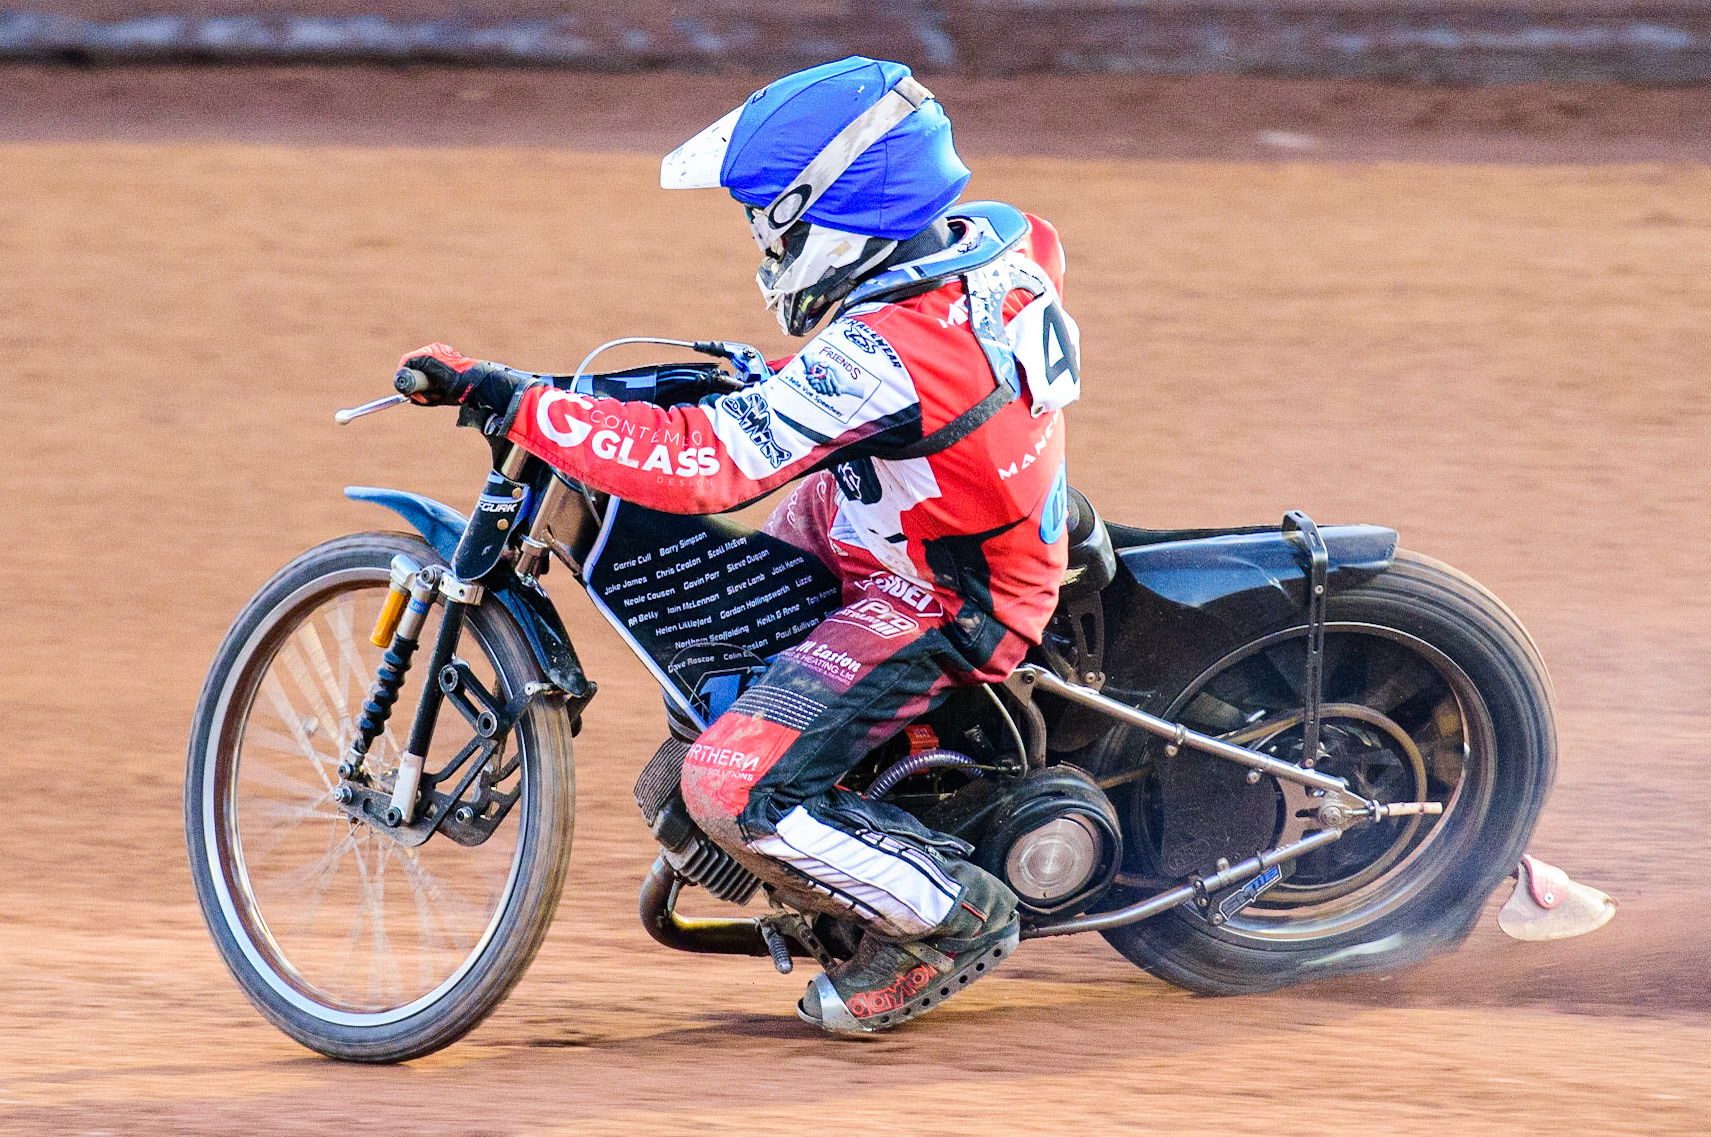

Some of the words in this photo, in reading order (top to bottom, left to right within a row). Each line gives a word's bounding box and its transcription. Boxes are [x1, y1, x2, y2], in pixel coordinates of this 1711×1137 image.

[1042, 300, 1079, 386] 4
[819, 345, 862, 381] FRIENDS
[802, 386, 814, 397] Vue
[591, 429, 720, 478] GLASS
[656, 476, 713, 488] DESIGN
[622, 576, 648, 588] James
[655, 566, 676, 580] Chris
[707, 547, 726, 560] Scott
[725, 536, 747, 552] McEvoy
[637, 553, 652, 565] Cull
[659, 544, 679, 557] Barry
[679, 531, 708, 549] Simpson
[682, 592, 720, 610] McLennan
[726, 581, 747, 596] Steve
[747, 573, 766, 588] Lamb
[683, 577, 705, 591] Gavin
[705, 570, 720, 582] Parr
[726, 559, 747, 573] Steve
[655, 625, 678, 637] Helen
[678, 615, 713, 631] Littleford
[720, 603, 746, 619] Gordon
[746, 584, 791, 610] Hollingsworth
[708, 624, 750, 644] Scaffolding
[756, 613, 776, 628] Keith
[775, 629, 792, 641] Paul
[792, 617, 820, 633] Sullivan
[801, 655, 840, 674] HEATING
[812, 643, 862, 673] Easton
